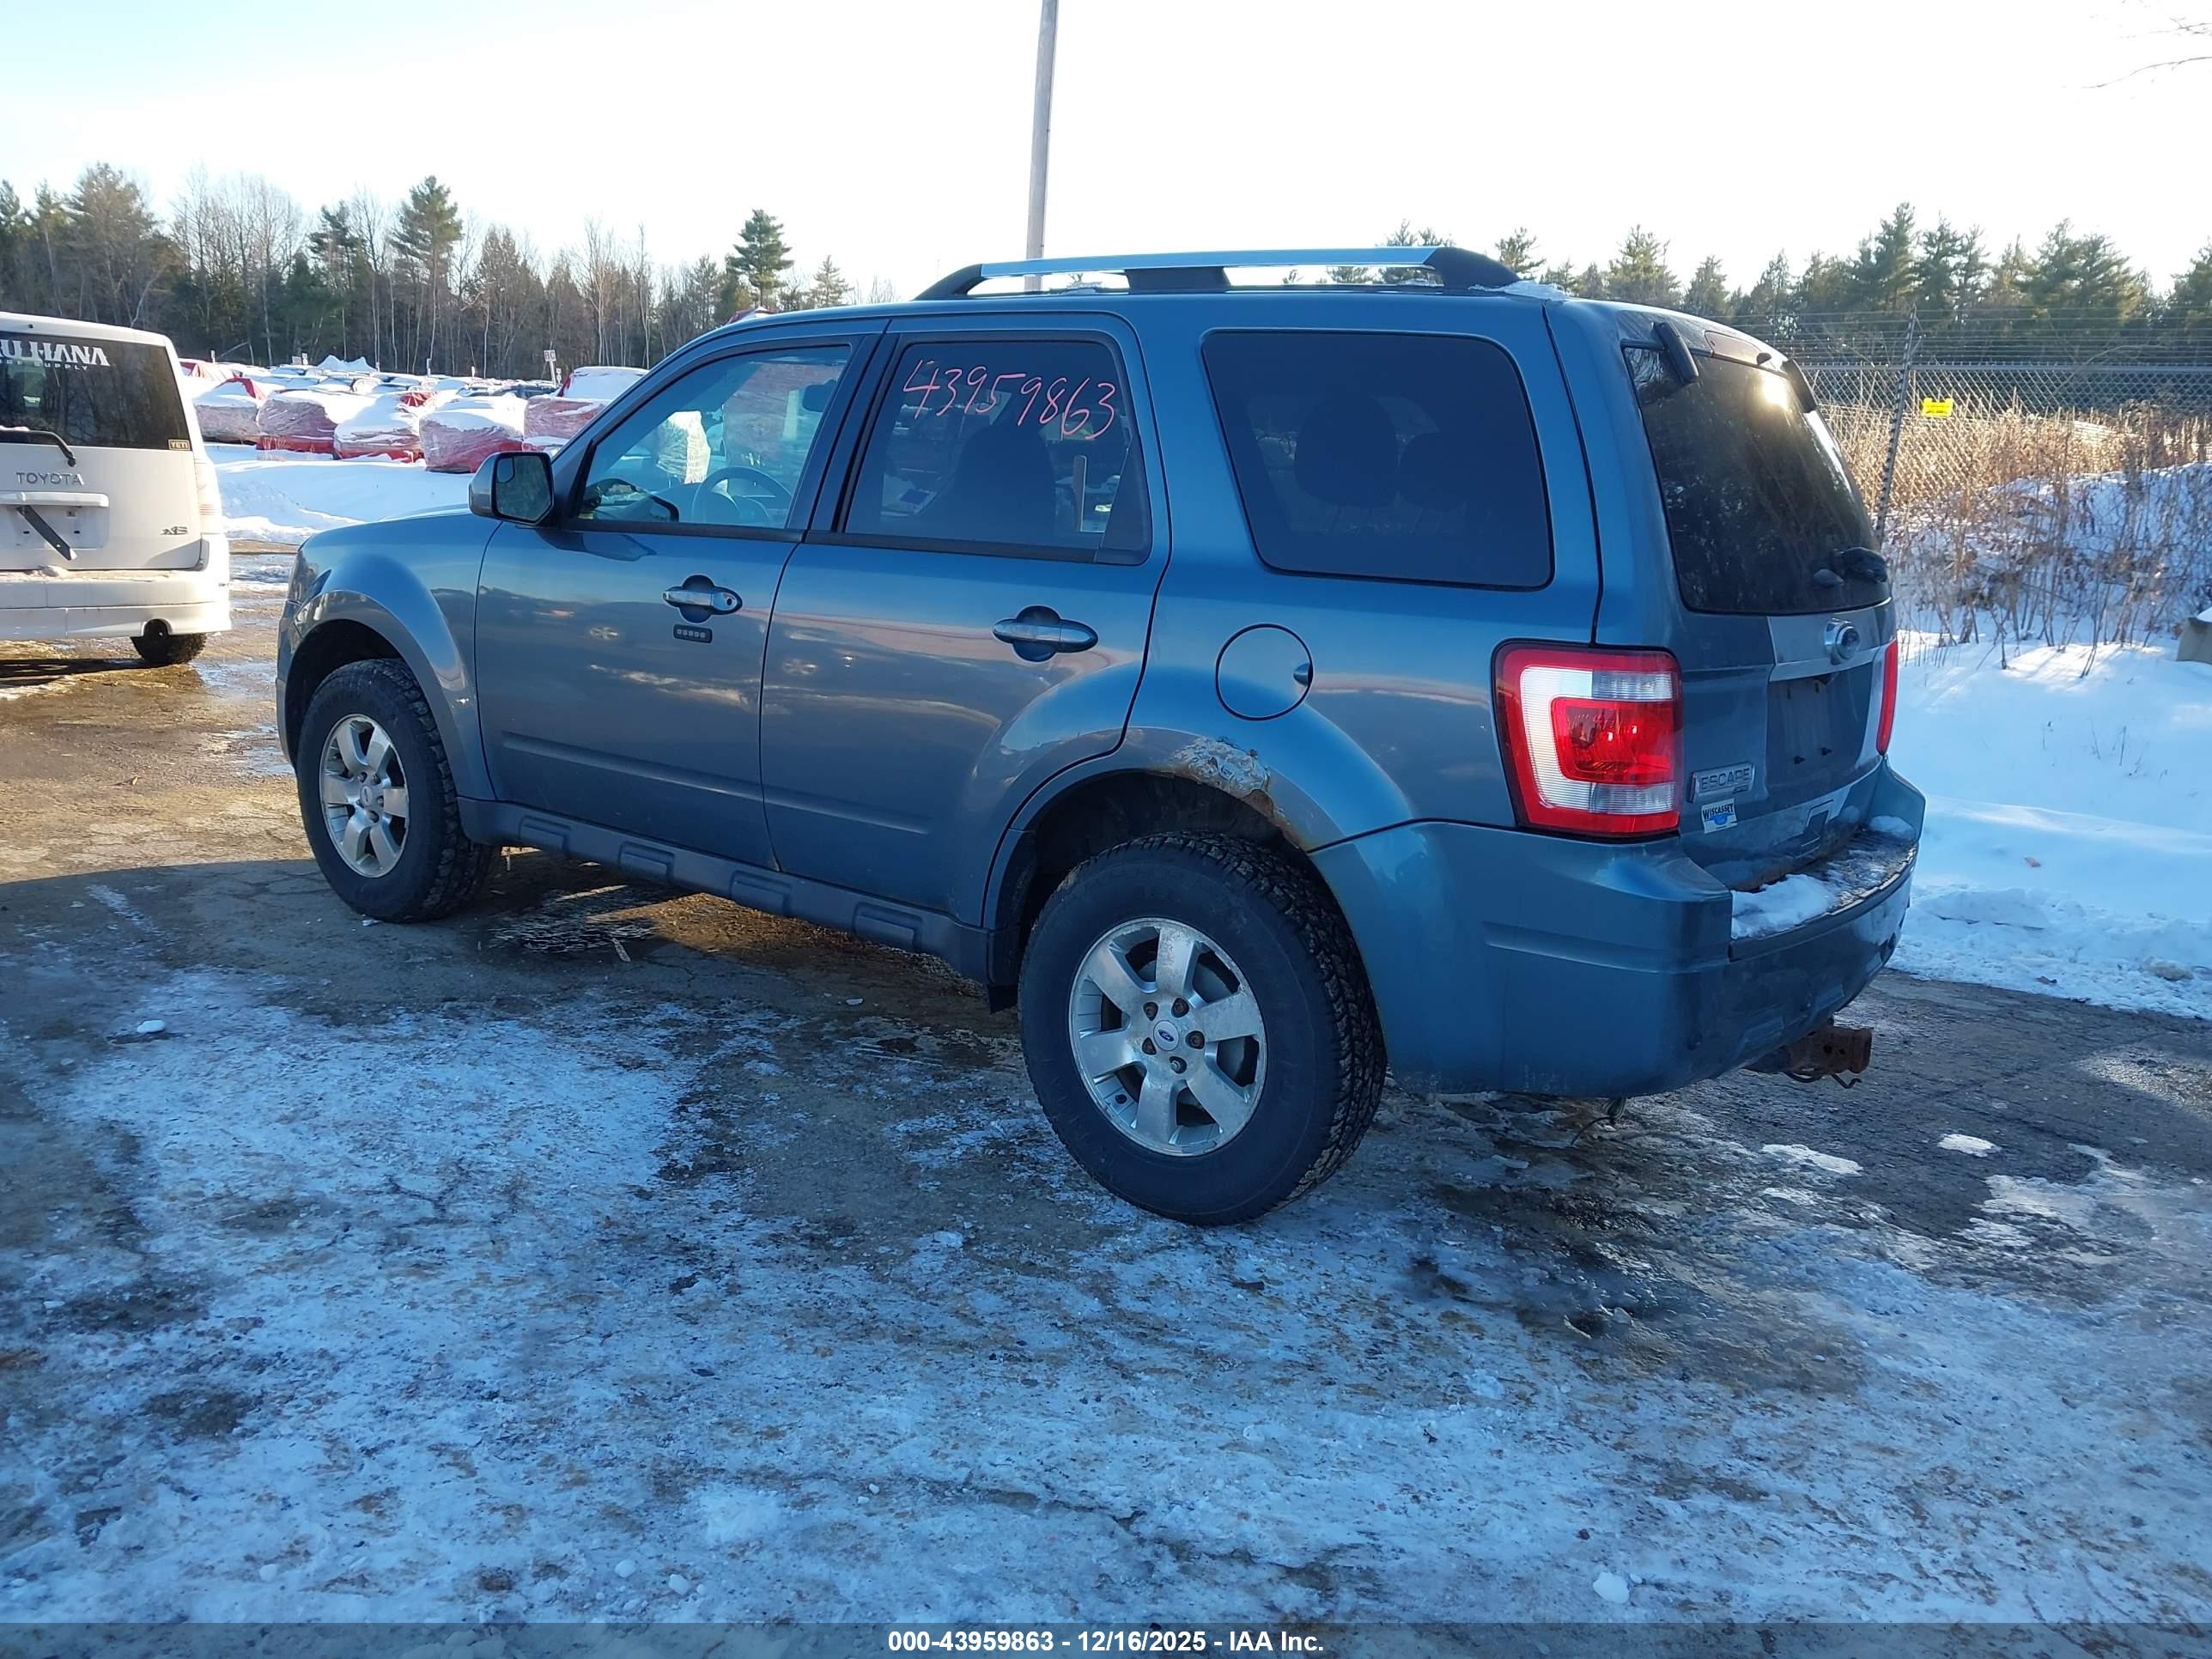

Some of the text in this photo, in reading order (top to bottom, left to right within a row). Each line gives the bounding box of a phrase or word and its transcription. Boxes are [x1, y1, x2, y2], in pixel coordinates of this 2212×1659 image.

[903, 359, 1115, 440] 43959863
[170, 441, 189, 449] YETI
[15, 472, 84, 486] TOYOTA
[1700, 768, 1751, 791] ESCAPE
[1702, 803, 1735, 821] WISCASSET
